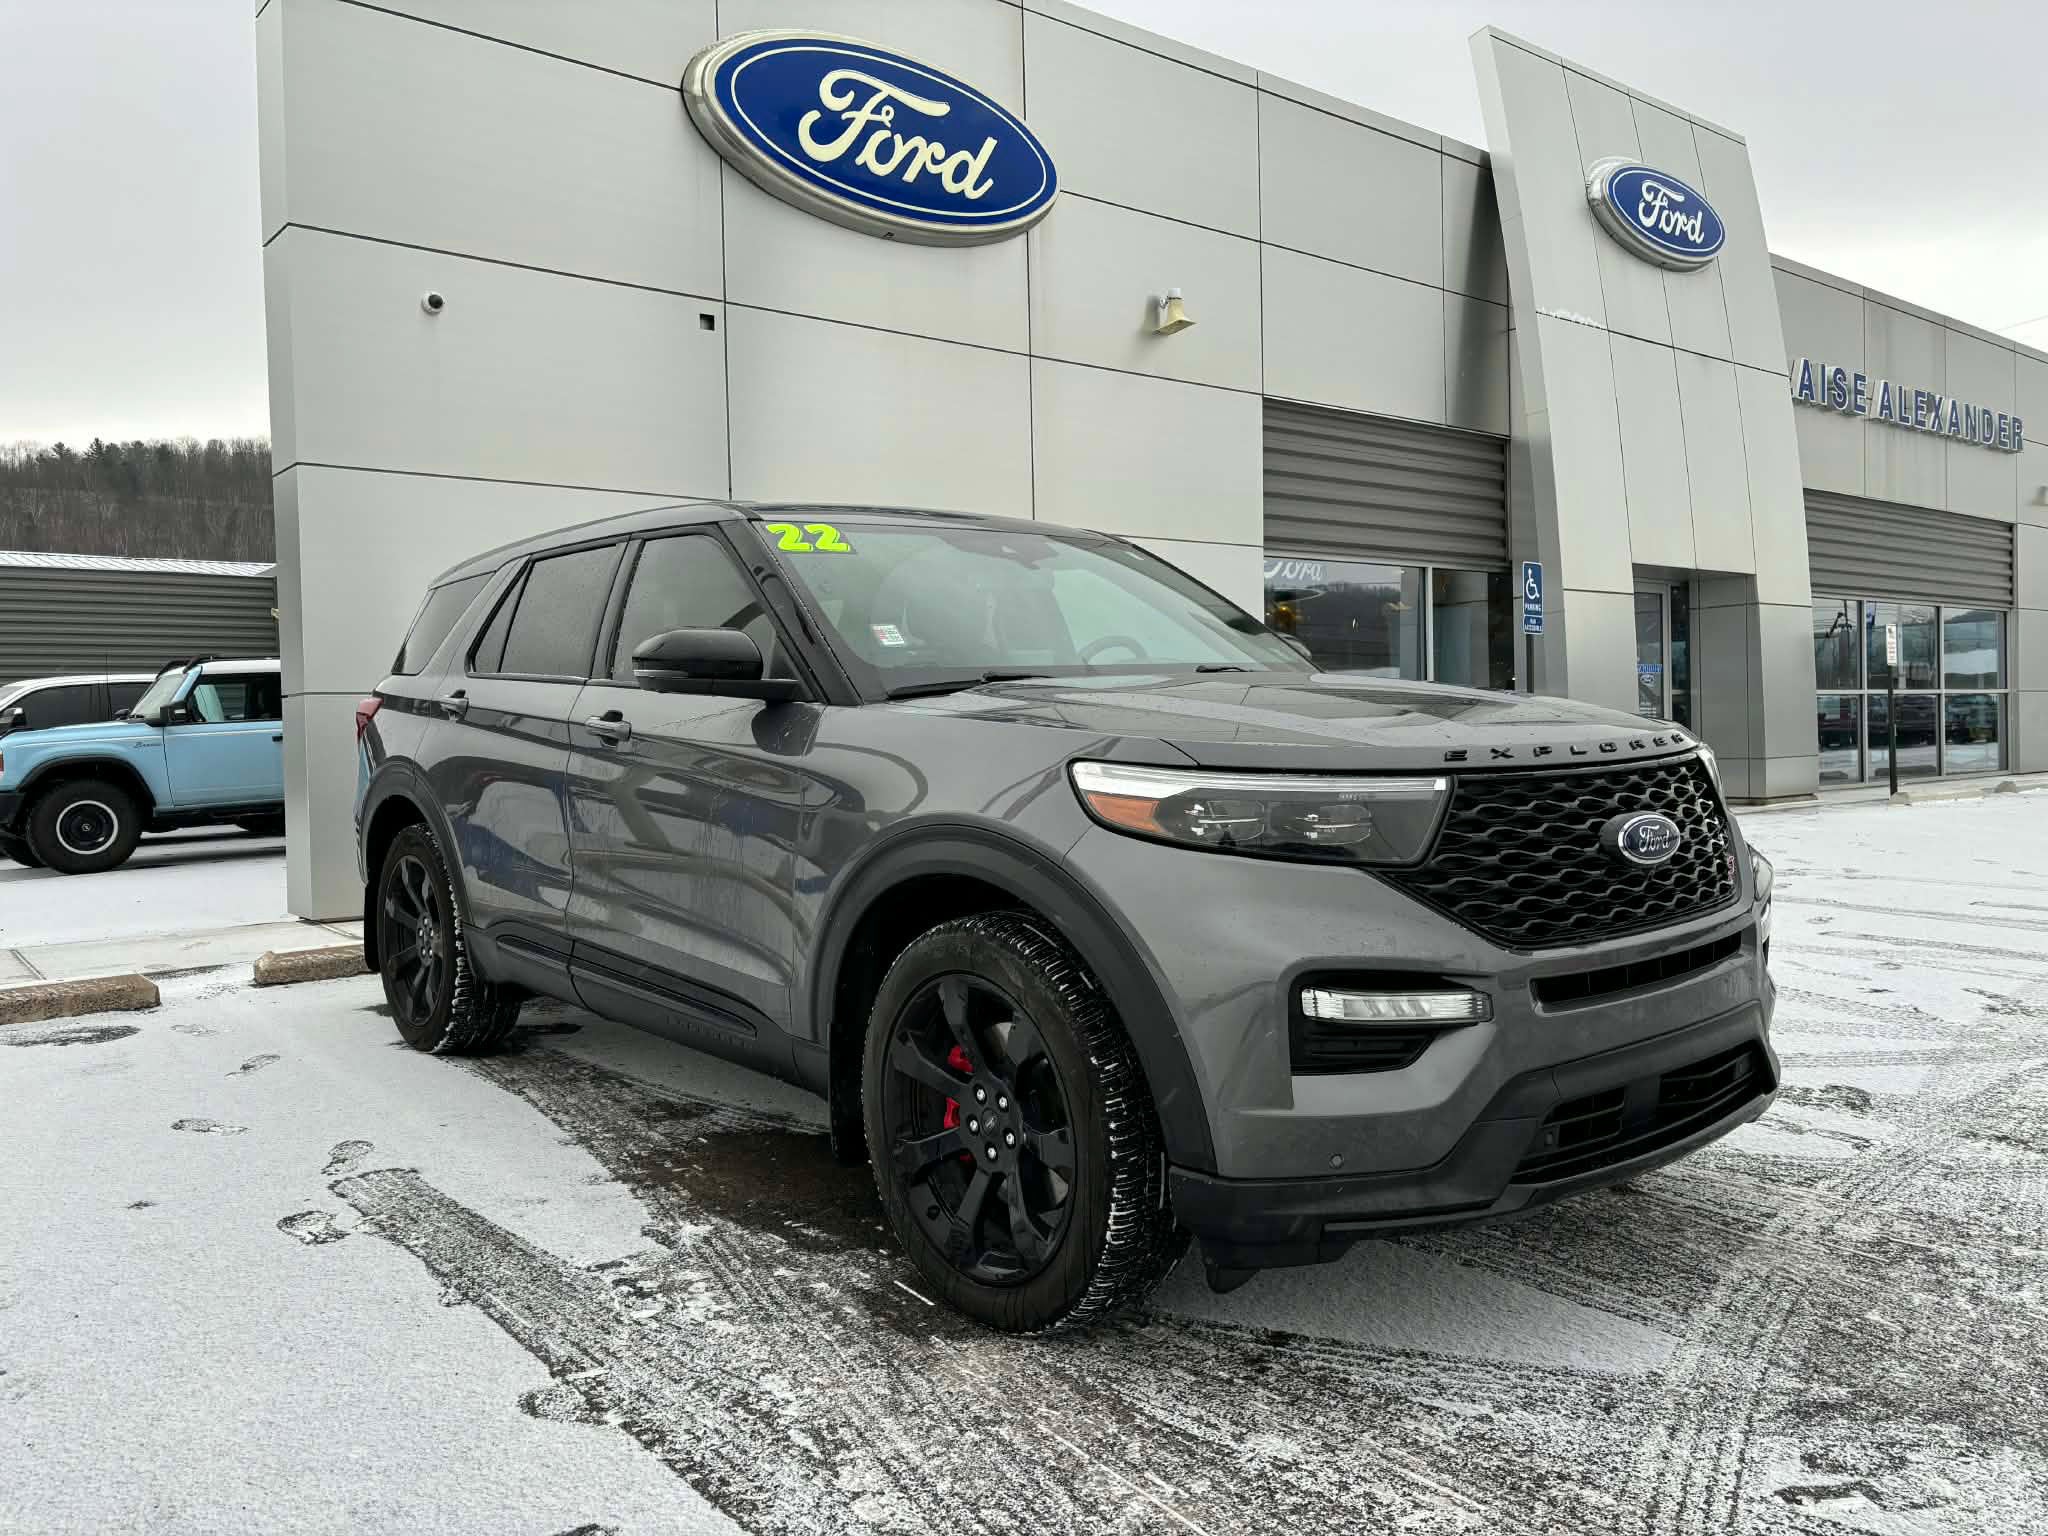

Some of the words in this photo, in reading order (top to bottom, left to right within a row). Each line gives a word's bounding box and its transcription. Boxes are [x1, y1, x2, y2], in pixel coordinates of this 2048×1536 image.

[798, 69, 998, 201] Ford
[1638, 179, 1705, 244] Ford
[1872, 379, 2024, 451] ALEXANDER
[766, 523, 851, 551] 22
[1443, 733, 1685, 762] EXPLORER
[1638, 824, 1671, 853] Ford
